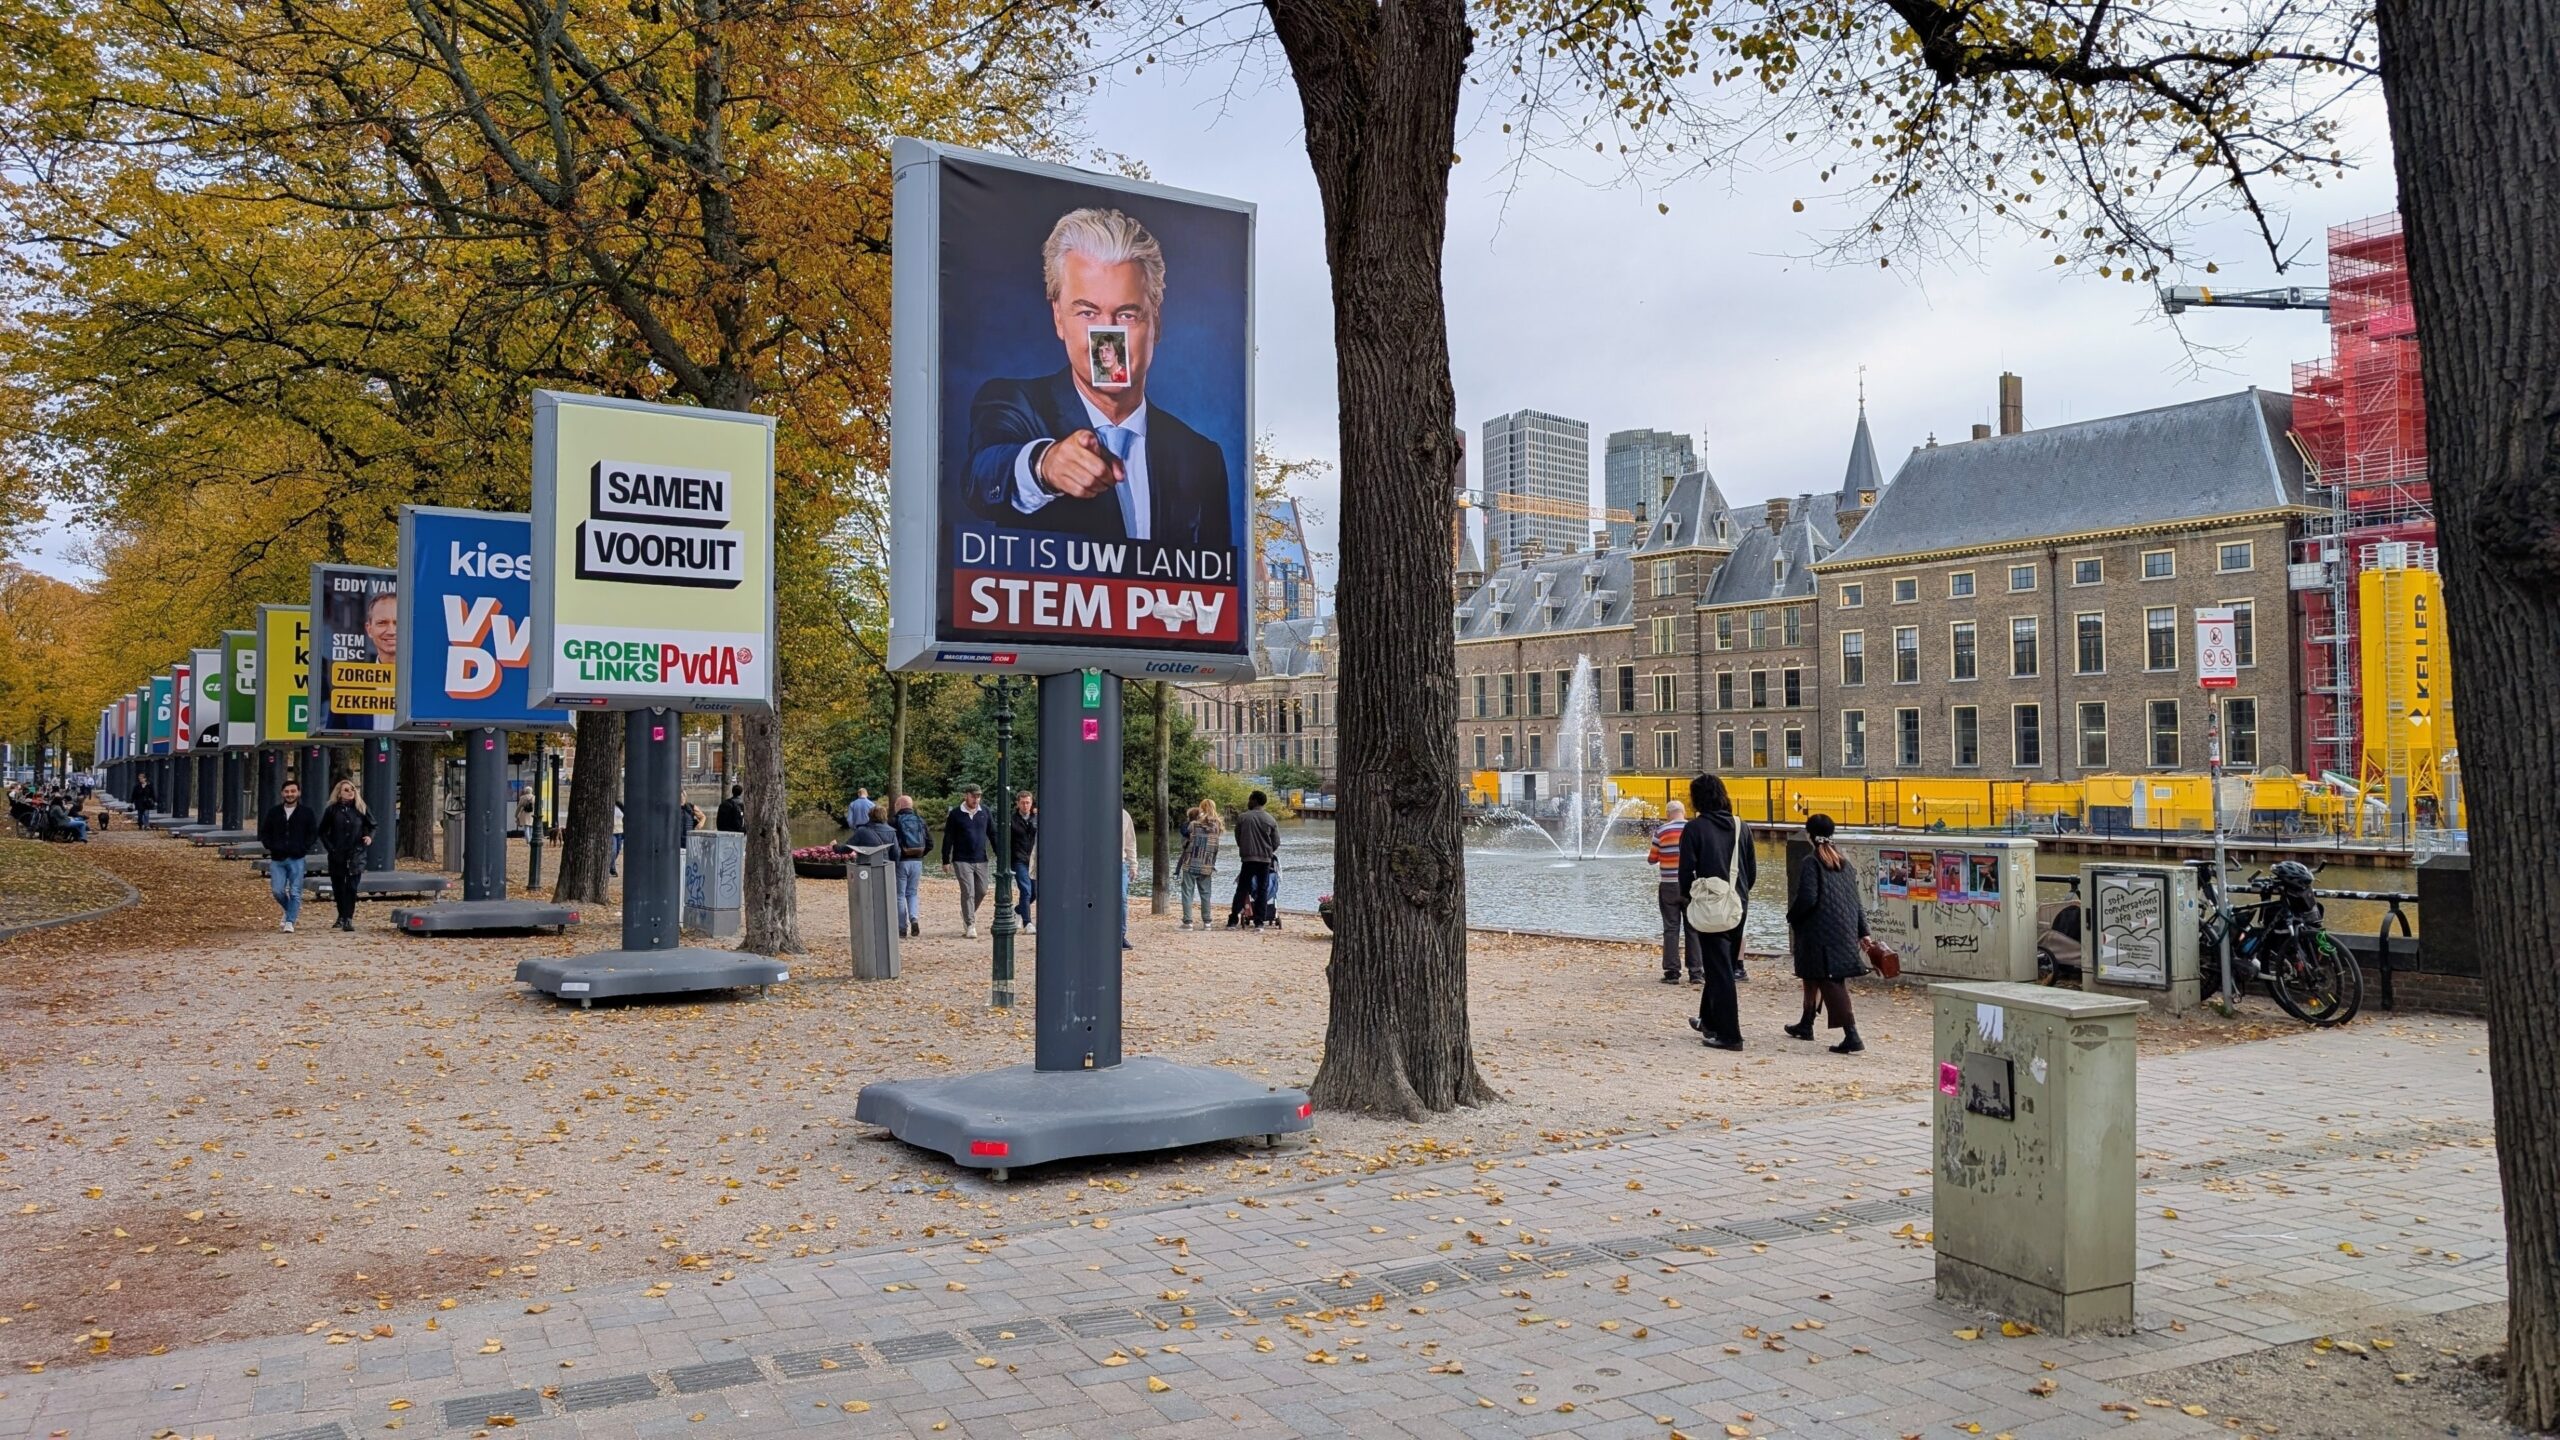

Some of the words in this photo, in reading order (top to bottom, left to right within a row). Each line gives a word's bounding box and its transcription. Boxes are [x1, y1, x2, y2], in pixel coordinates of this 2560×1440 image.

[607, 470, 723, 512] SAMEN
[449, 541, 531, 580] kies
[593, 530, 737, 571] VOORUIT
[961, 532, 1019, 567] DIT
[1030, 538, 1057, 569] IS
[1066, 541, 1127, 574] UW
[1136, 547, 1233, 582] LAND!
[334, 577, 367, 592] EDDY
[371, 580, 397, 594] VAN
[970, 576, 1113, 629] STEM
[1126, 586, 1226, 635] PVV
[332, 633, 365, 647] STEM
[563, 639, 659, 662] GROEN
[2414, 593, 2430, 699] KELLER
[336, 668, 391, 683] ZORGEN
[580, 661, 659, 683] LINKS
[660, 643, 739, 685] PvdA
[2104, 896, 2158, 915] conversations
[2107, 894, 2125, 906] soft
